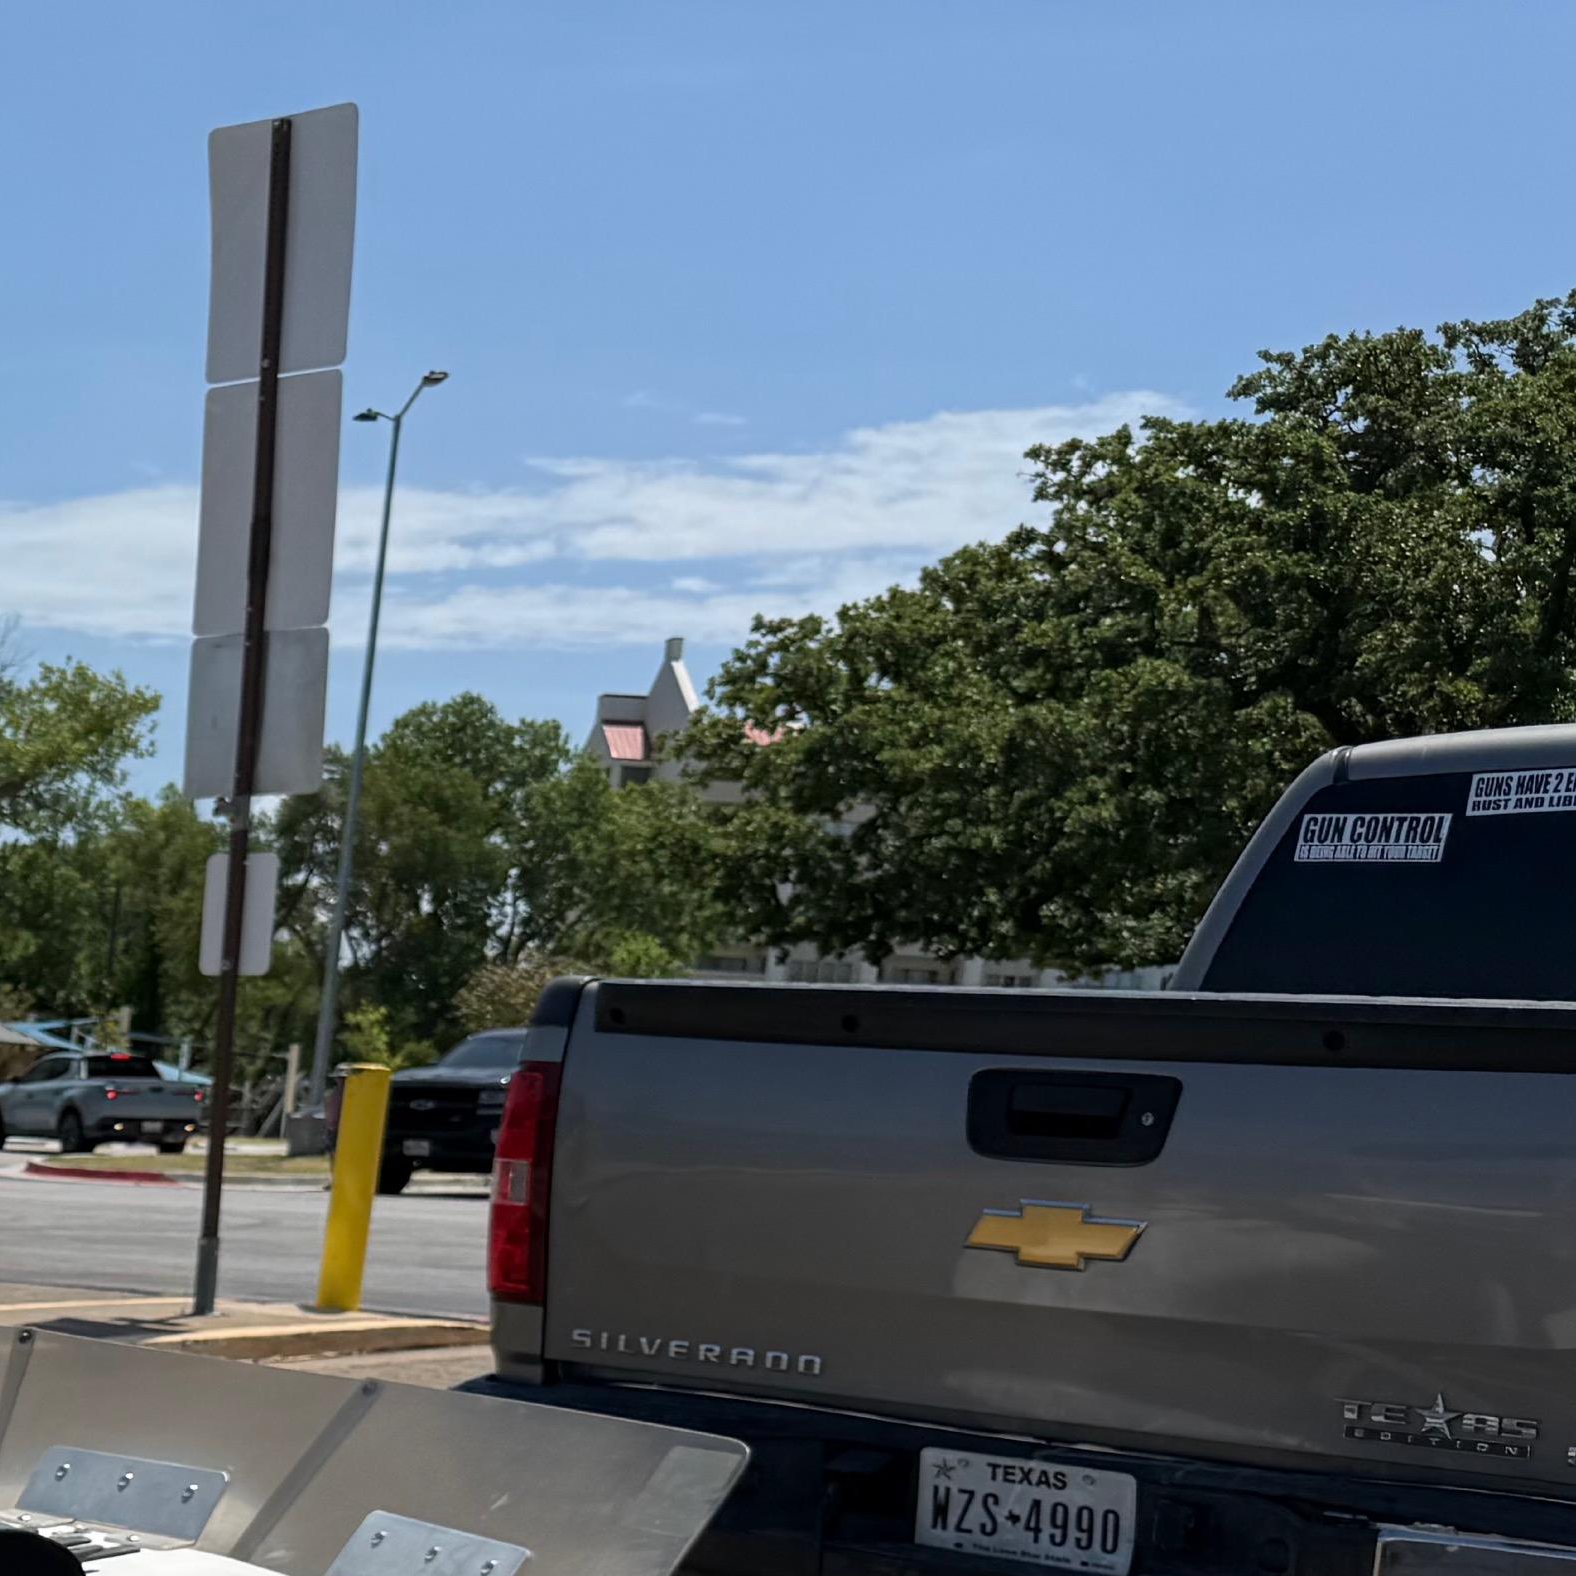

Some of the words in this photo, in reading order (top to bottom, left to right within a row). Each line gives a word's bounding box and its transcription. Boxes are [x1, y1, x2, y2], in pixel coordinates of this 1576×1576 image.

[1475, 775, 1513, 798] GUNS
[1515, 773, 1552, 796] HAVE
[1552, 772, 1564, 793] 2
[1471, 798, 1511, 812] RUST
[1513, 796, 1545, 810] AND
[1303, 816, 1347, 844] GUN
[1350, 815, 1445, 844] CONTROL
[571, 1328, 822, 1375] SILVERADO
[986, 1462, 1068, 1491] TEXAS
[931, 1484, 999, 1538] WZS
[1024, 1499, 1121, 1555] 4990
